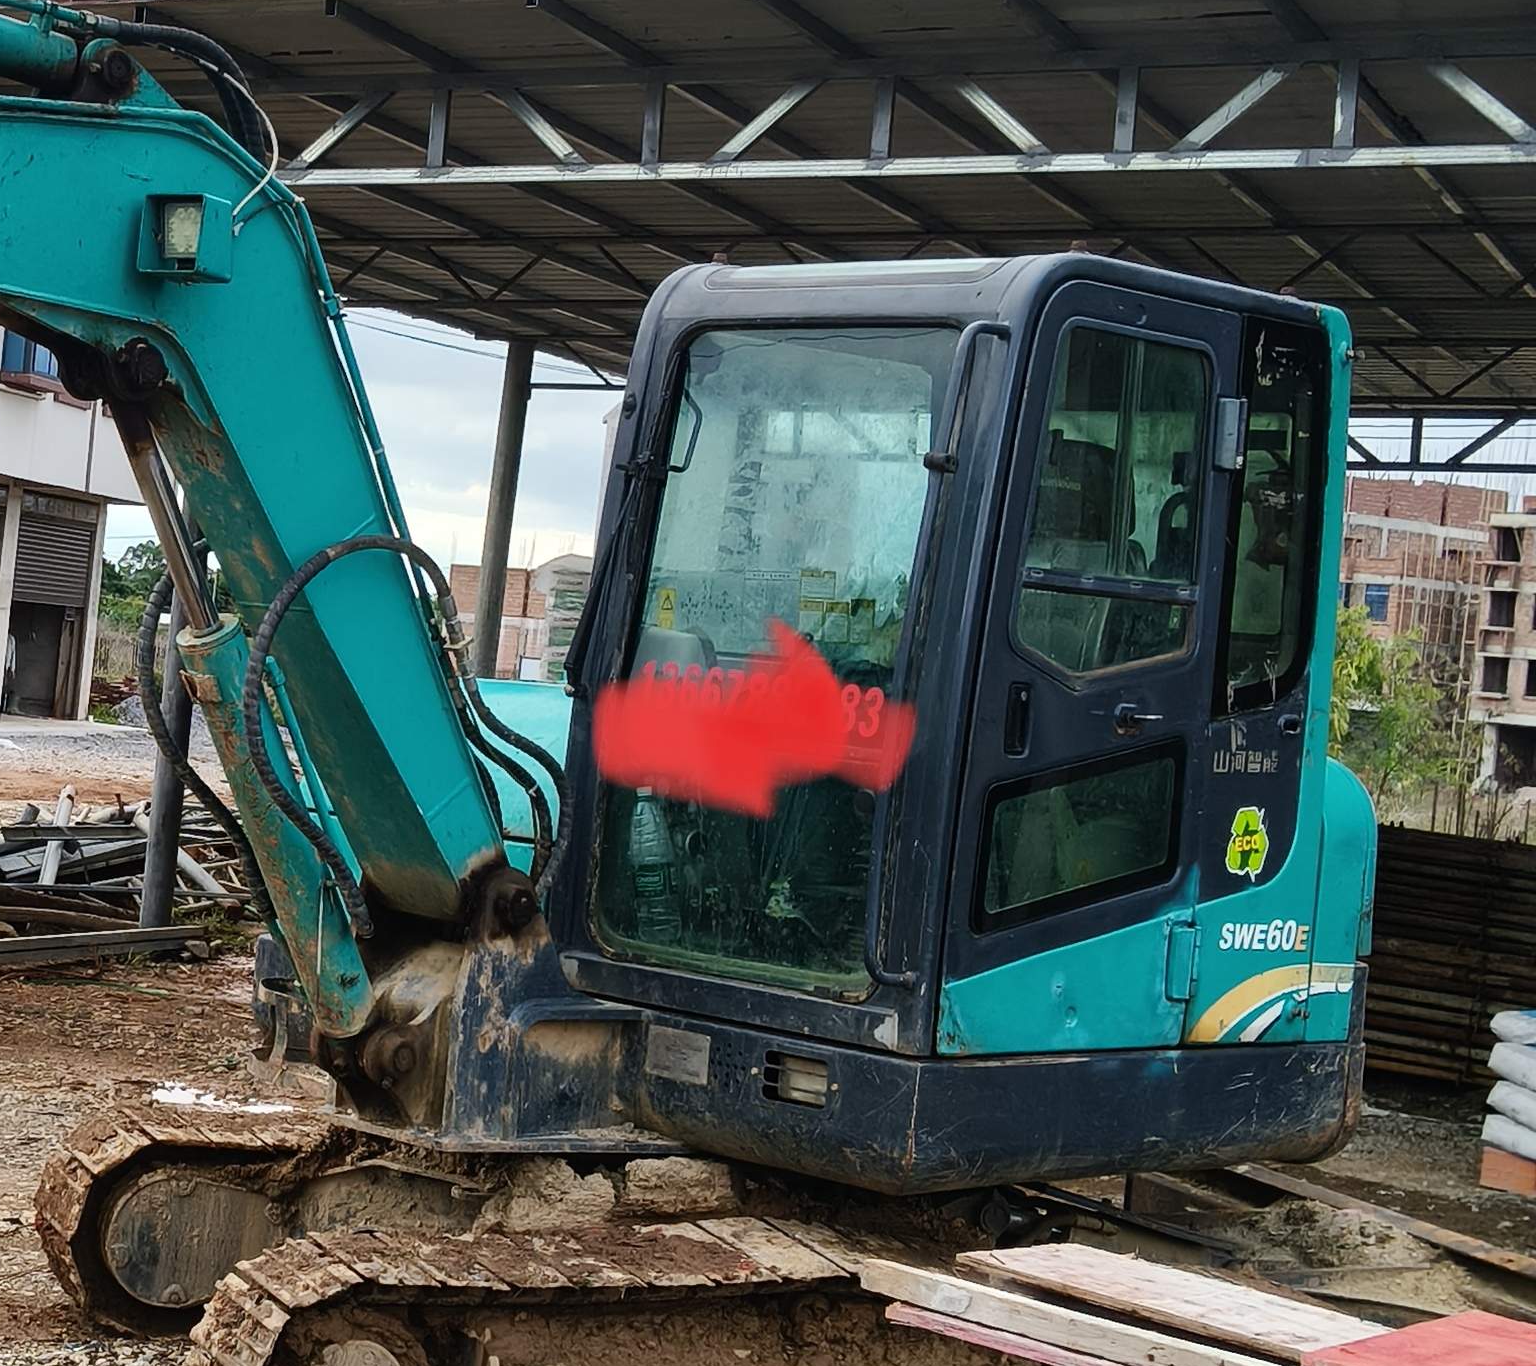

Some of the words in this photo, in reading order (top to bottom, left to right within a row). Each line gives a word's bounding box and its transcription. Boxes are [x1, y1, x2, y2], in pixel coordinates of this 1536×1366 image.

[1213, 749, 1279, 773] 山河智能
[1234, 835, 1260, 852] ECO
[1219, 919, 1310, 952] SWE60E
